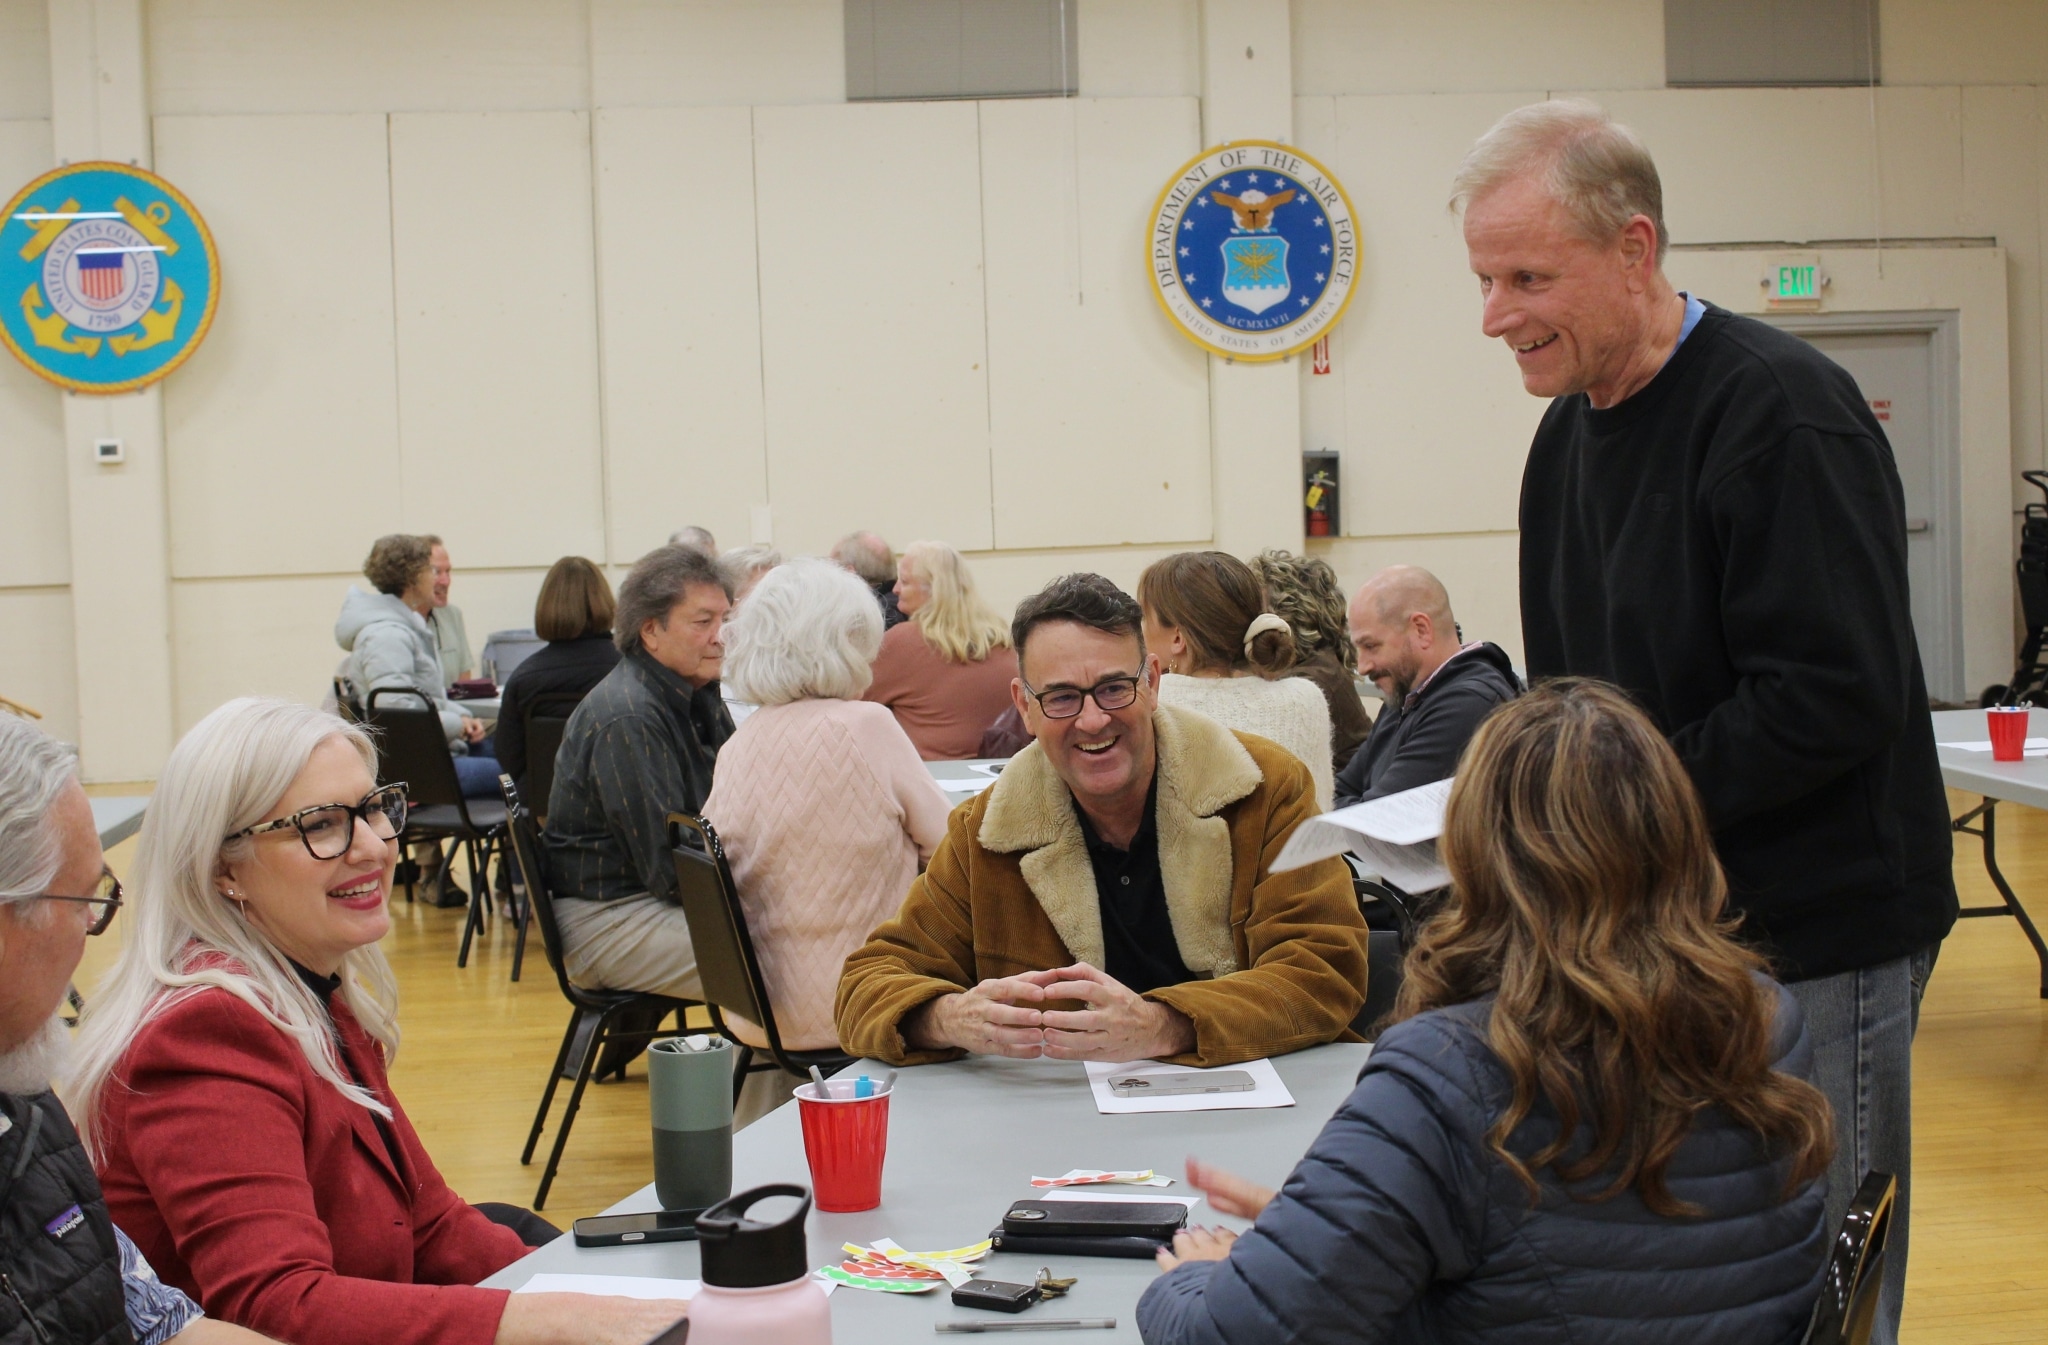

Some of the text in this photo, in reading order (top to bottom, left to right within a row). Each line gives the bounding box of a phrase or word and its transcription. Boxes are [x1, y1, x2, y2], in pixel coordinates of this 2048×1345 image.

[1156, 149, 1354, 288] DEPARTMENT OF THE AIR FORCE
[55, 223, 102, 258] STATES
[48, 258, 74, 313] UNITED
[131, 259, 154, 310] GUARD
[1779, 266, 1814, 296] EXIT
[88, 313, 122, 328] 1790
[1177, 301, 1335, 349] UNITED STATES OF AMERICA
[1225, 312, 1290, 330] MCMXLVII
